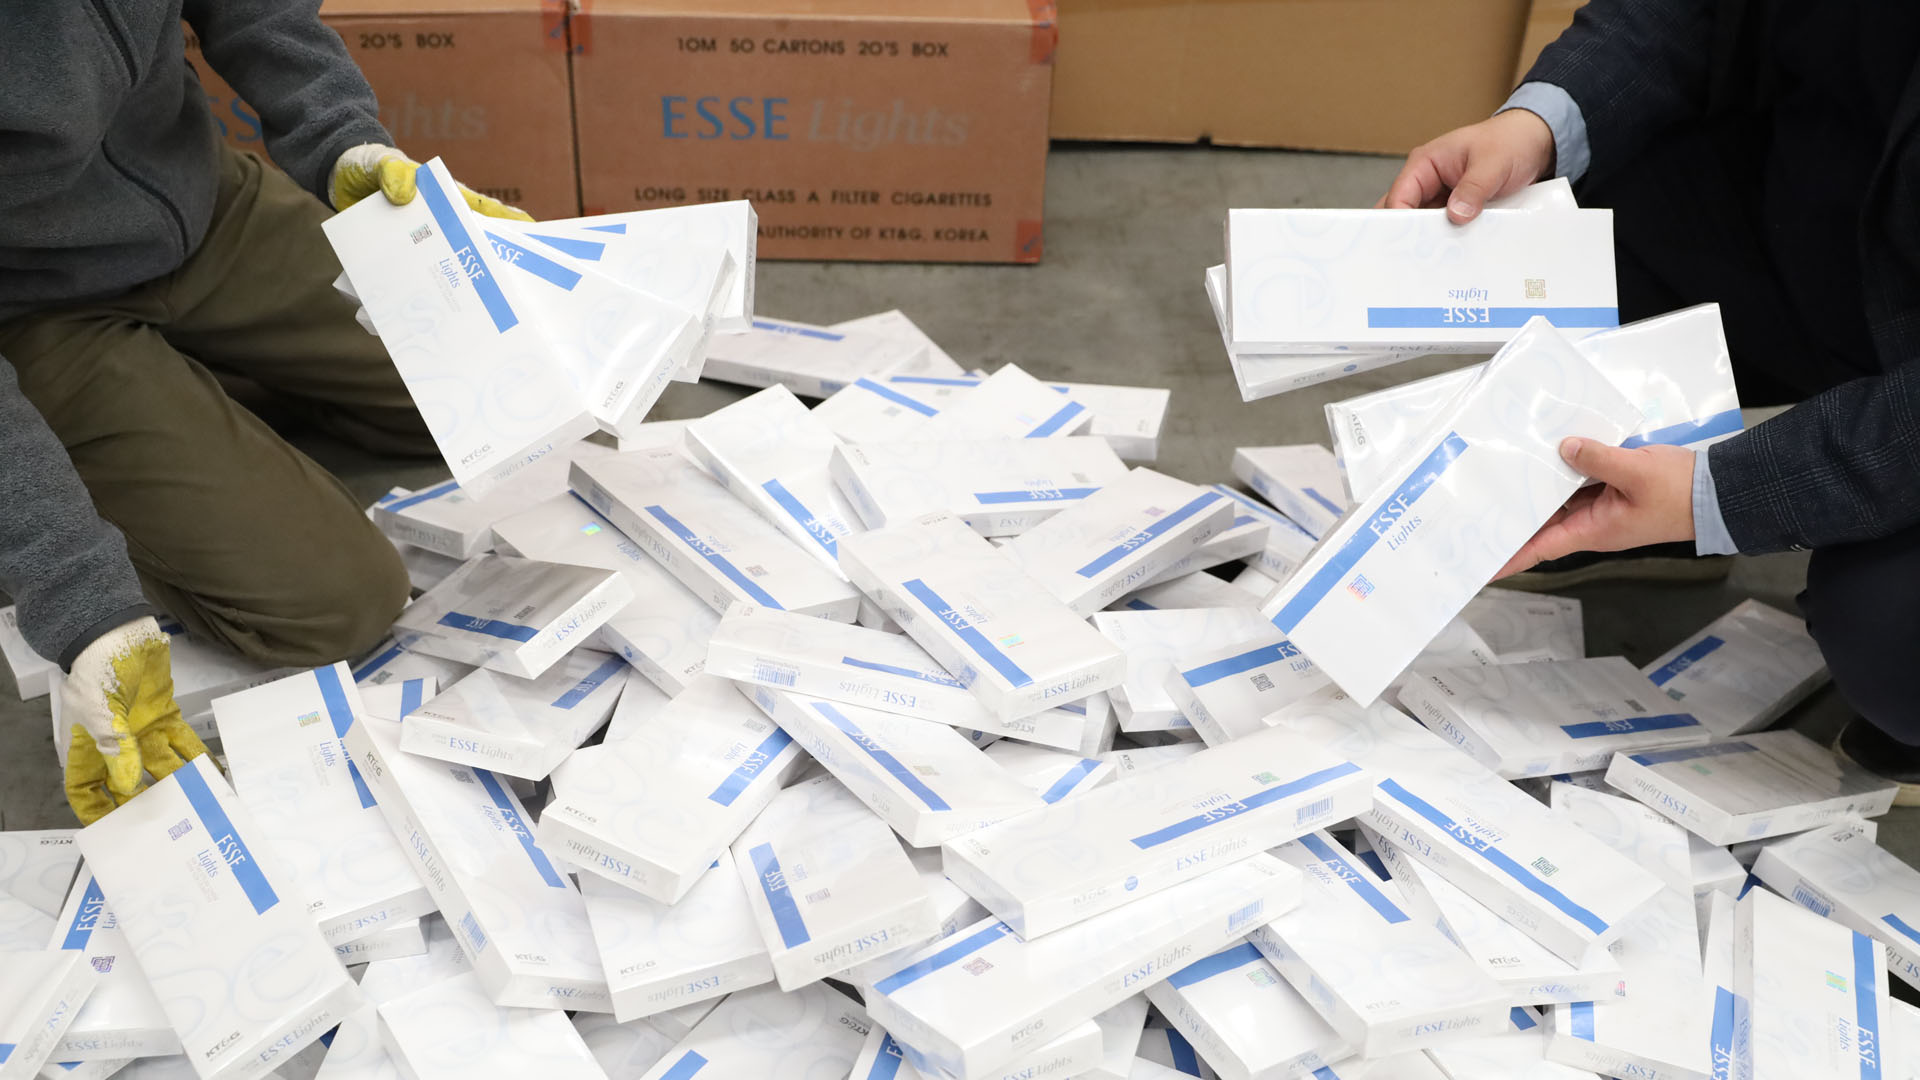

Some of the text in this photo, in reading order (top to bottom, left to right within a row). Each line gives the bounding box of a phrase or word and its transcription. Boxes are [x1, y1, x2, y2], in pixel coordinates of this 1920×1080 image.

[360, 34, 454, 48] 20'S BOX
[730, 39, 755, 53] 50
[763, 39, 844, 54] CARTONS
[858, 42, 898, 56] 20'S
[912, 43, 948, 57] BOX
[661, 96, 970, 151] ESSE Lights
[634, 188, 991, 207] LONG SIZE CLASS A FILTER CIGARETTES
[851, 226, 870, 239] OF
[934, 228, 989, 242] KOREA
[439, 258, 460, 289] Lights
[454, 246, 484, 281] ESSE
[1448, 288, 1489, 301] Lights
[1443, 307, 1490, 323] ESSE
[602, 380, 624, 408] KT&G
[1350, 413, 1366, 446] KT&G
[461, 443, 492, 465] KT&G
[527, 443, 553, 465] ESSE
[1029, 489, 1064, 499] ESSE
[1369, 493, 1410, 539] ESSE
[803, 517, 837, 544] ESSE
[1120, 531, 1152, 551] ESSE
[1386, 514, 1422, 551] Lights
[556, 599, 607, 641] ESSE Lights
[938, 607, 971, 631] ESSE
[1277, 643, 1302, 660] ES
[1289, 658, 1313, 674] Ligh
[839, 680, 916, 708] ESSE Lights
[1044, 674, 1100, 699] ESSE Lights
[1442, 719, 1465, 746] ESSE
[318, 740, 336, 768] Lights
[448, 737, 513, 761] ESSE Lights
[741, 751, 768, 773] ESSE
[366, 751, 383, 777] KT&G
[1203, 801, 1248, 823] ESSE
[1663, 793, 1689, 815] ESSE
[500, 808, 529, 840] ESSE
[1443, 821, 1489, 852] ESSE
[1465, 816, 1502, 844] Lights
[215, 833, 246, 868] ESSE
[1176, 836, 1248, 871] ESSE Lights
[1377, 835, 1398, 860] ESSE
[1401, 830, 1431, 857] ESSE
[197, 849, 219, 879] Lights
[410, 831, 447, 892] ESSE Lights
[567, 839, 630, 877] ESSE Lights
[1305, 862, 1334, 885] Lights
[1323, 859, 1363, 885] ESSE
[76, 896, 105, 932] ESSE
[354, 910, 388, 929] ESSE
[335, 945, 353, 955] SE
[814, 929, 888, 964] ESSE Lights
[1123, 943, 1192, 988] ESSE Lights
[1488, 956, 1522, 964] KT&G
[546, 986, 576, 998] ESSE
[647, 976, 720, 1002] ESSE Lights
[259, 1008, 330, 1062] ESSE Lights
[1011, 1019, 1045, 1043] KT&G
[1415, 1016, 1481, 1036] ESSE Lights
[1836, 1016, 1851, 1052] Lights
[67, 1039, 101, 1051] ESSE
[205, 1030, 241, 1059] KT&G
[1857, 1026, 1877, 1069] ESSE
[1036, 1055, 1073, 1076] Lights
[1623, 1063, 1657, 1080] ESSE
